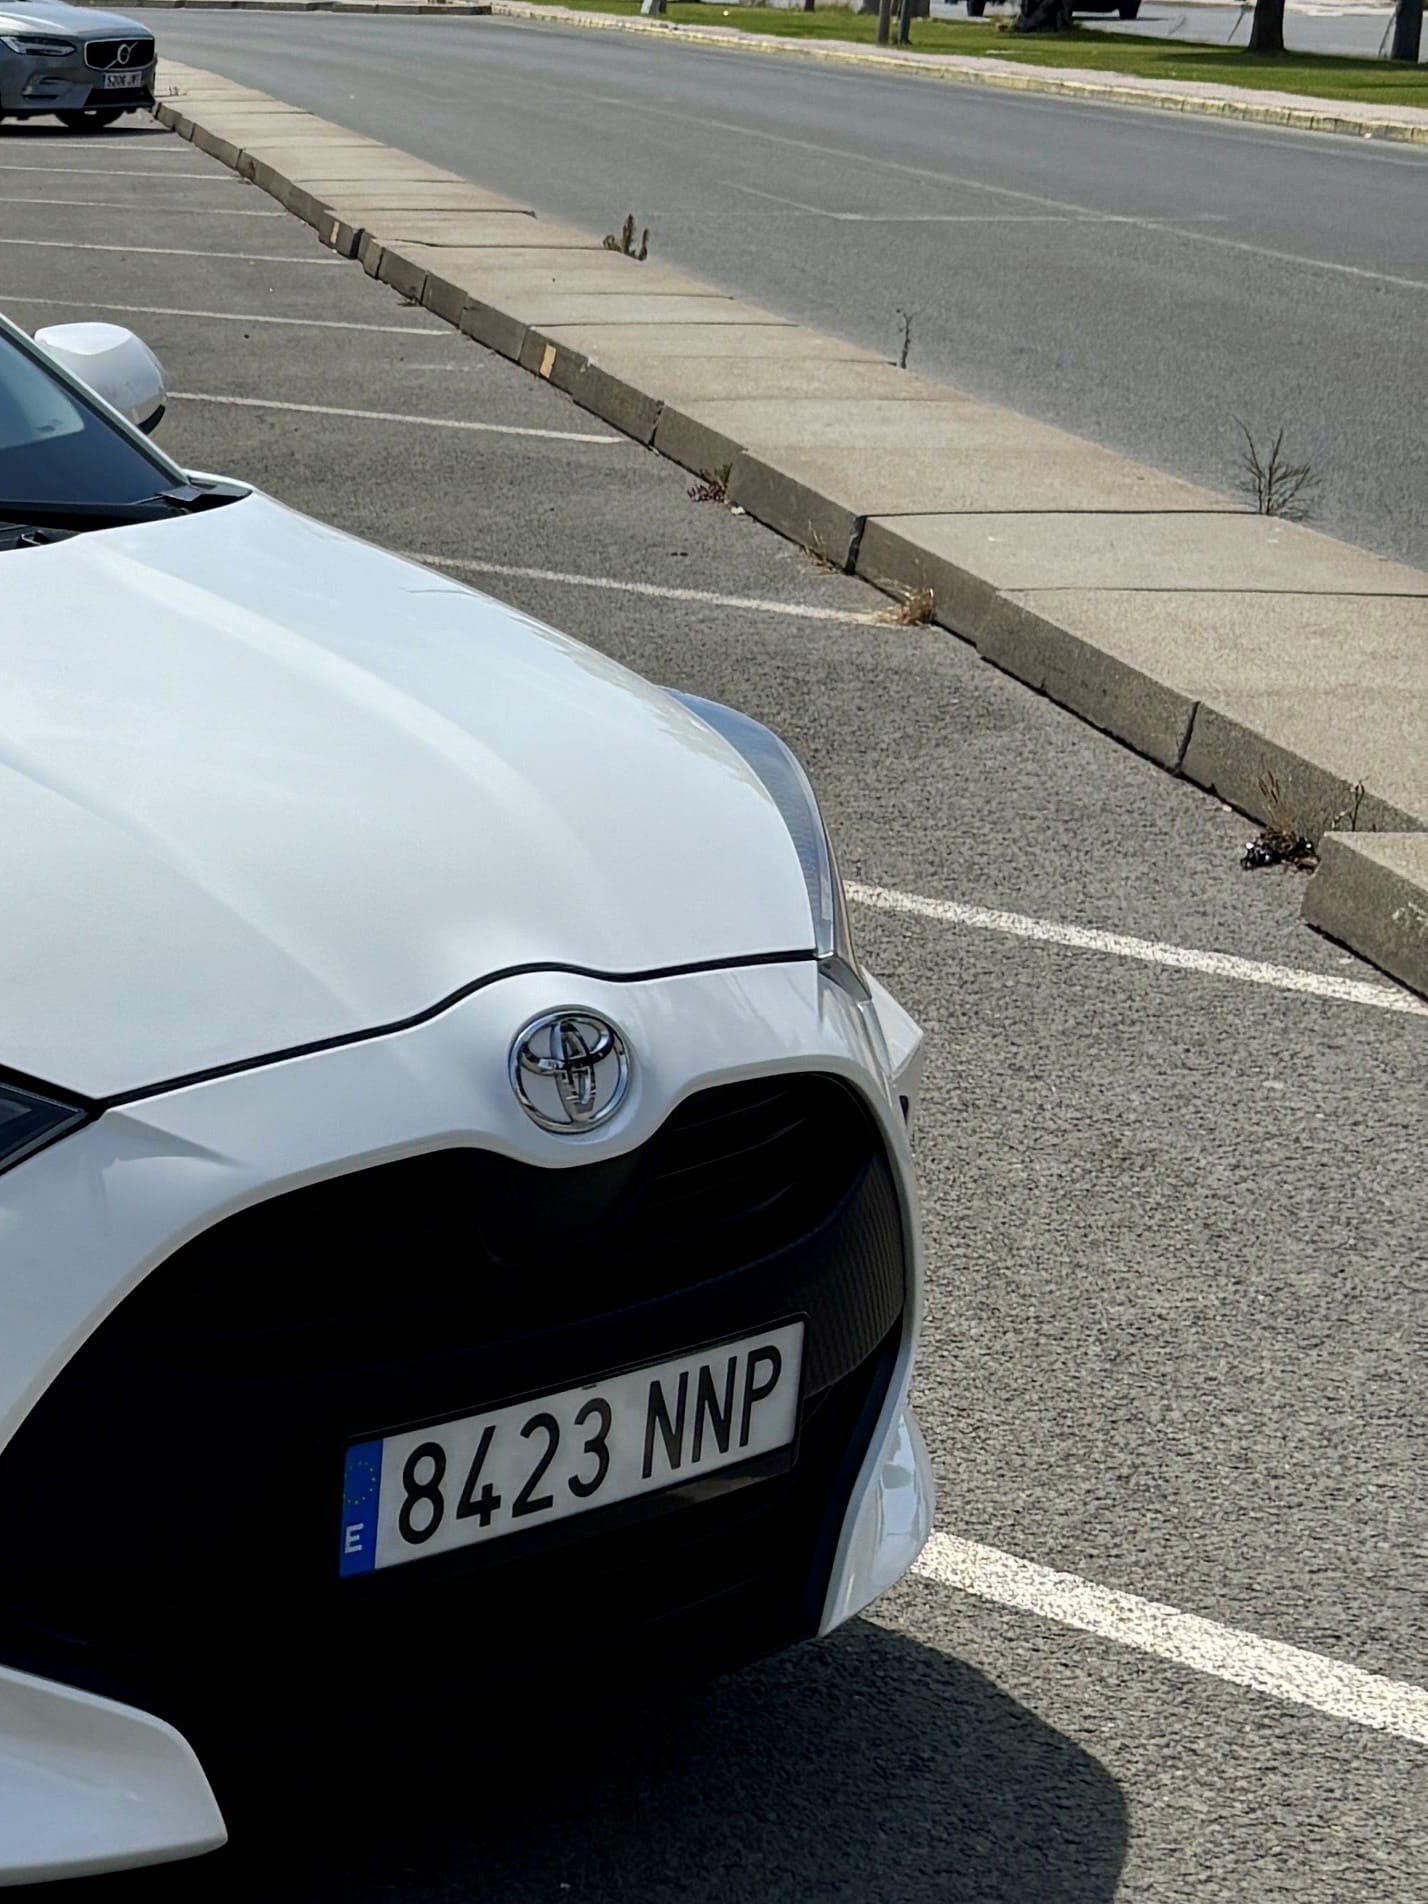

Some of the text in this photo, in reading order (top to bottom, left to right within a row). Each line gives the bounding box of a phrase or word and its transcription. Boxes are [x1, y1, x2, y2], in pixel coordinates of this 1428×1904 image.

[398, 1344, 782, 1546] 8423 NNP
[343, 1523, 365, 1555] E
